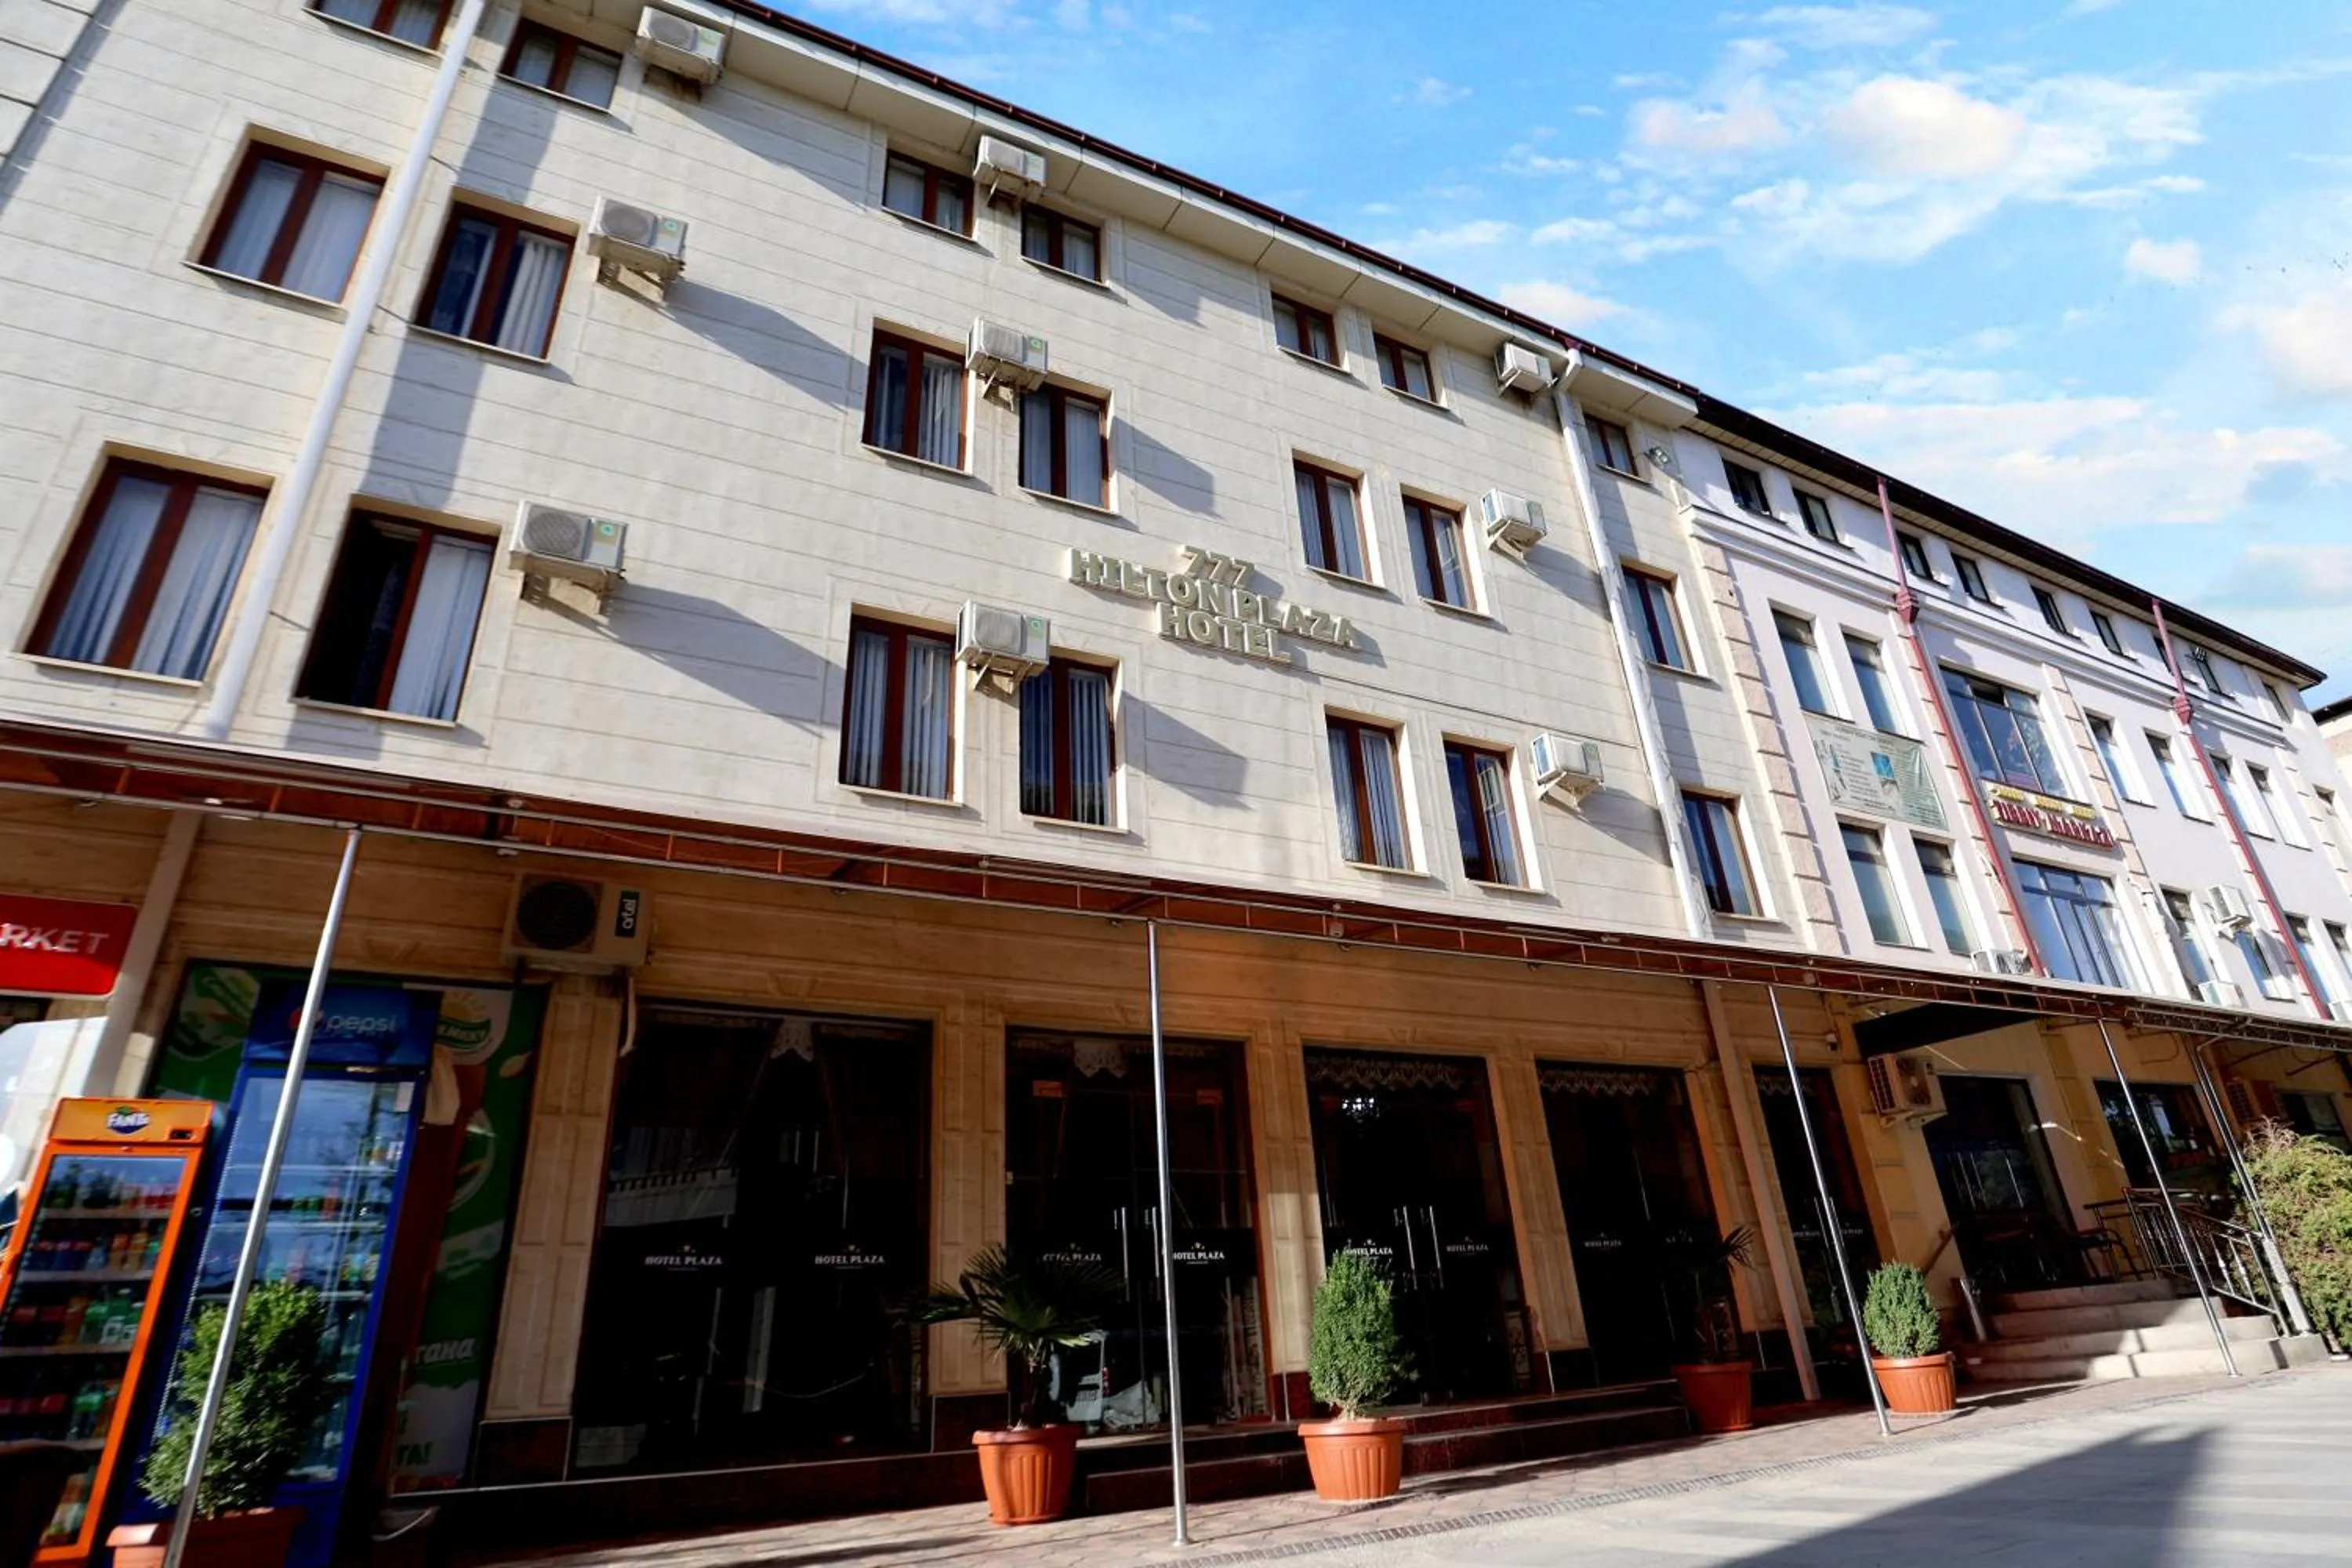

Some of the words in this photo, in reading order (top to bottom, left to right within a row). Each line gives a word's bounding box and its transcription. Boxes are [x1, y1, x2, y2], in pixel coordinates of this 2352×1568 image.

[1180, 545, 1254, 587] 777
[1068, 548, 1226, 614] HILTON
[1232, 584, 1357, 648] PLAZA
[1154, 601, 1293, 666] HOTEL
[325, 1014, 397, 1034] pepsi
[644, 1256, 681, 1266] HOTEL
[684, 1256, 723, 1266] PLAZA
[815, 1255, 848, 1265] HOTEL
[850, 1254, 885, 1265] PLAZA
[1197, 1250, 1225, 1261] PLAZA
